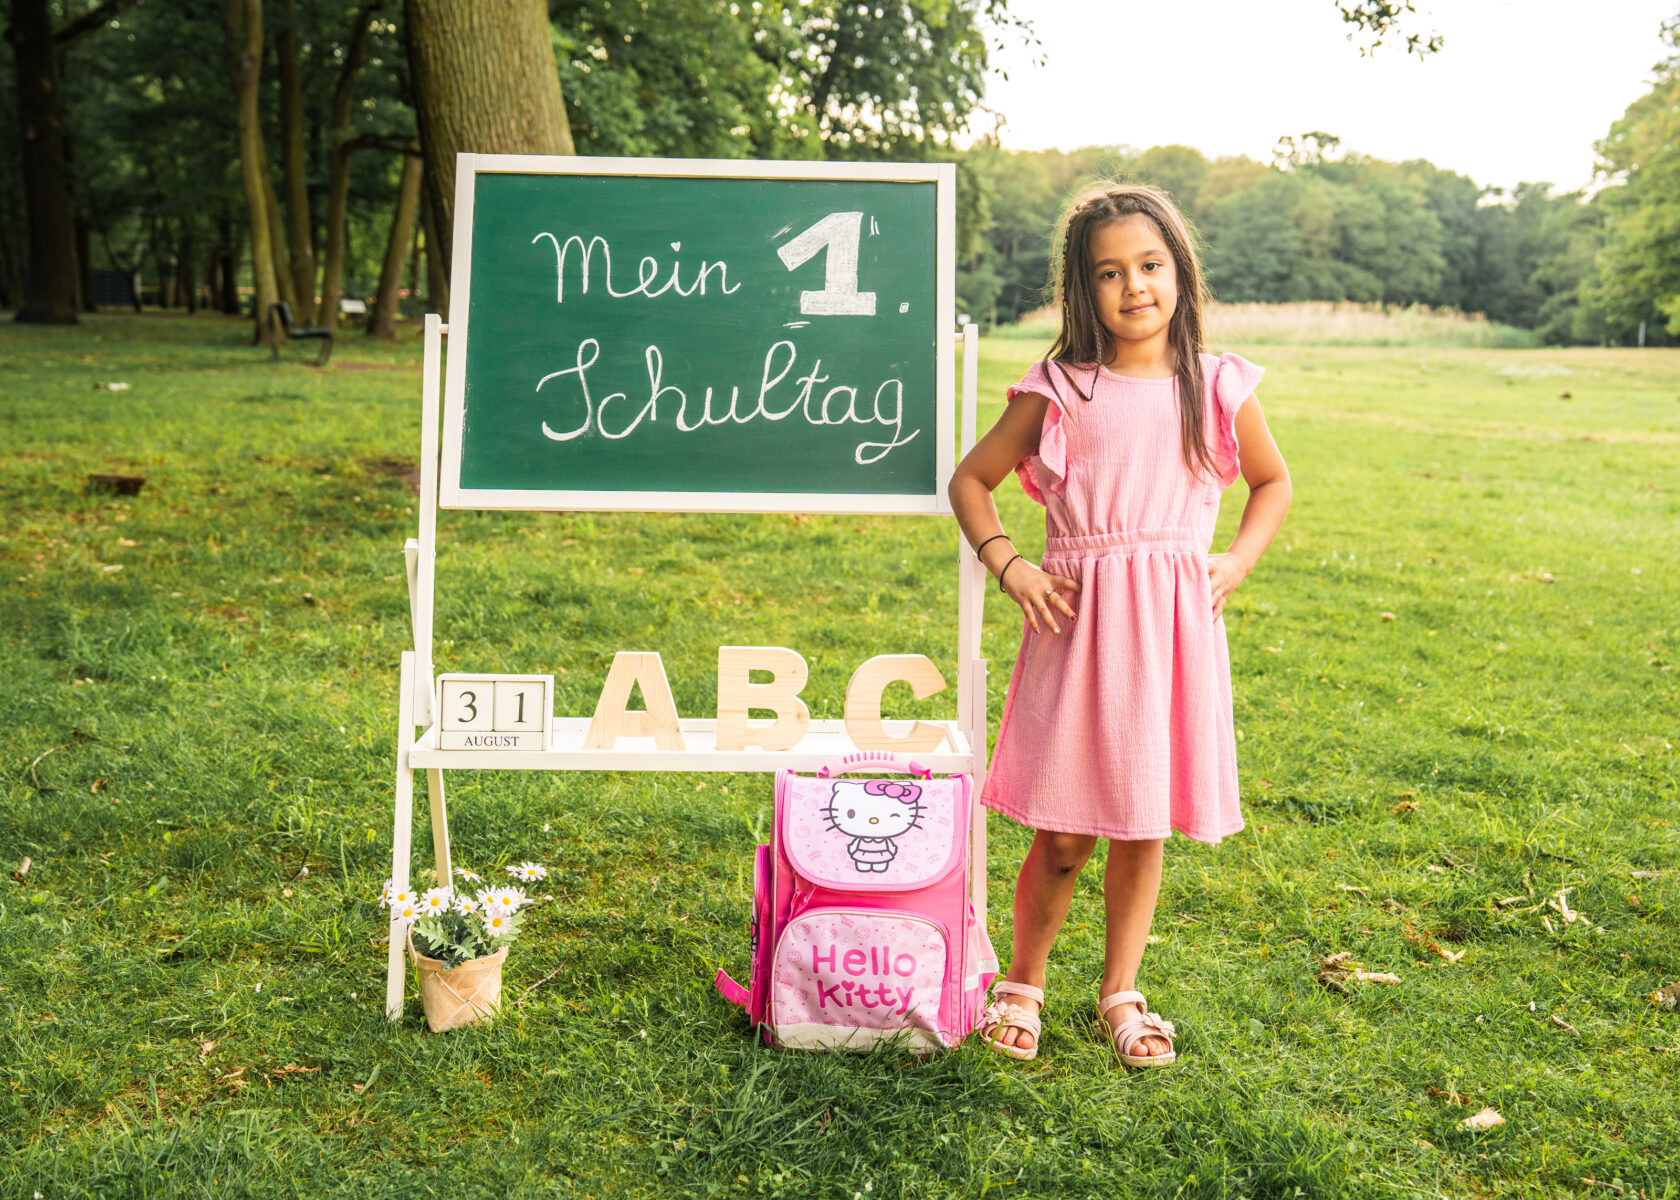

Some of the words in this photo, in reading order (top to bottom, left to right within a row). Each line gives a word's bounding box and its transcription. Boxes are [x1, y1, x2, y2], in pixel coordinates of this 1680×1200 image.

[531, 231, 741, 303] Mein
[535, 337, 921, 465] Schultag
[464, 735, 520, 747] AUGUST
[812, 943, 917, 977] Hello
[816, 979, 915, 1016] Kitty
